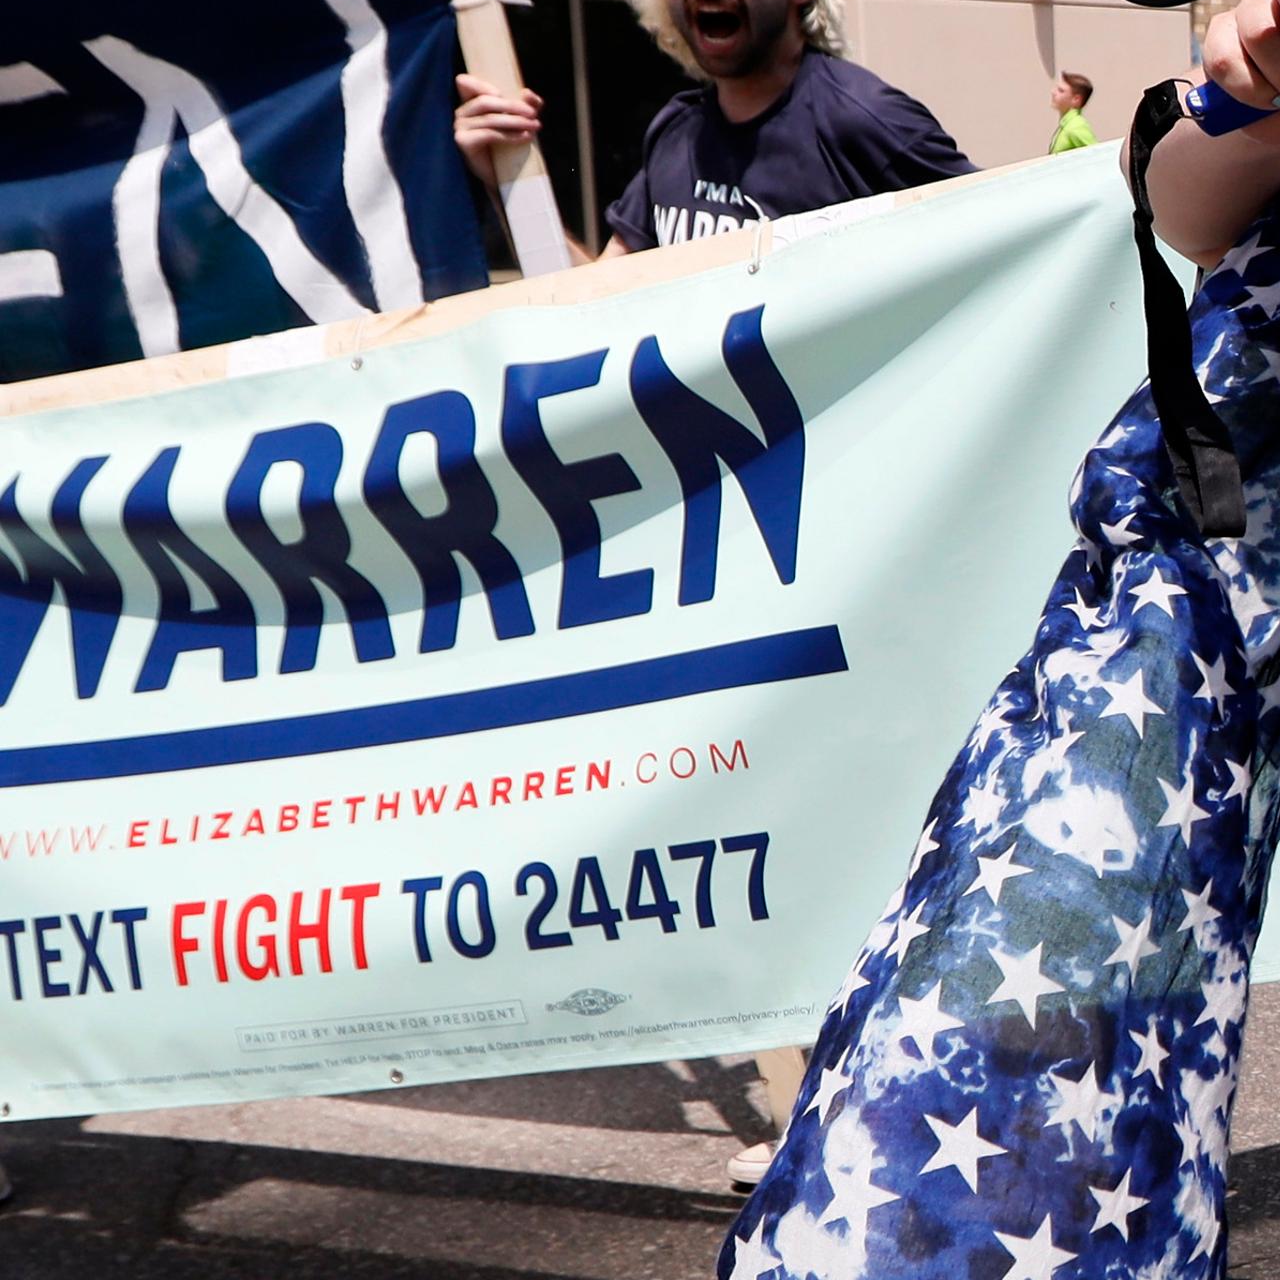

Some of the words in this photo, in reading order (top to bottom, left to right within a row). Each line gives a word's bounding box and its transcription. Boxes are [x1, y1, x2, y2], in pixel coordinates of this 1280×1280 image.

[693, 180, 728, 204] I'M
[729, 187, 744, 206] A
[0, 907, 148, 1001] TEXT
[170, 882, 381, 987] FIGHT
[402, 869, 495, 964] TO
[514, 831, 772, 949] 24477
[334, 1020, 396, 1037] WARREN
[432, 1007, 517, 1026] PRESIDENT
